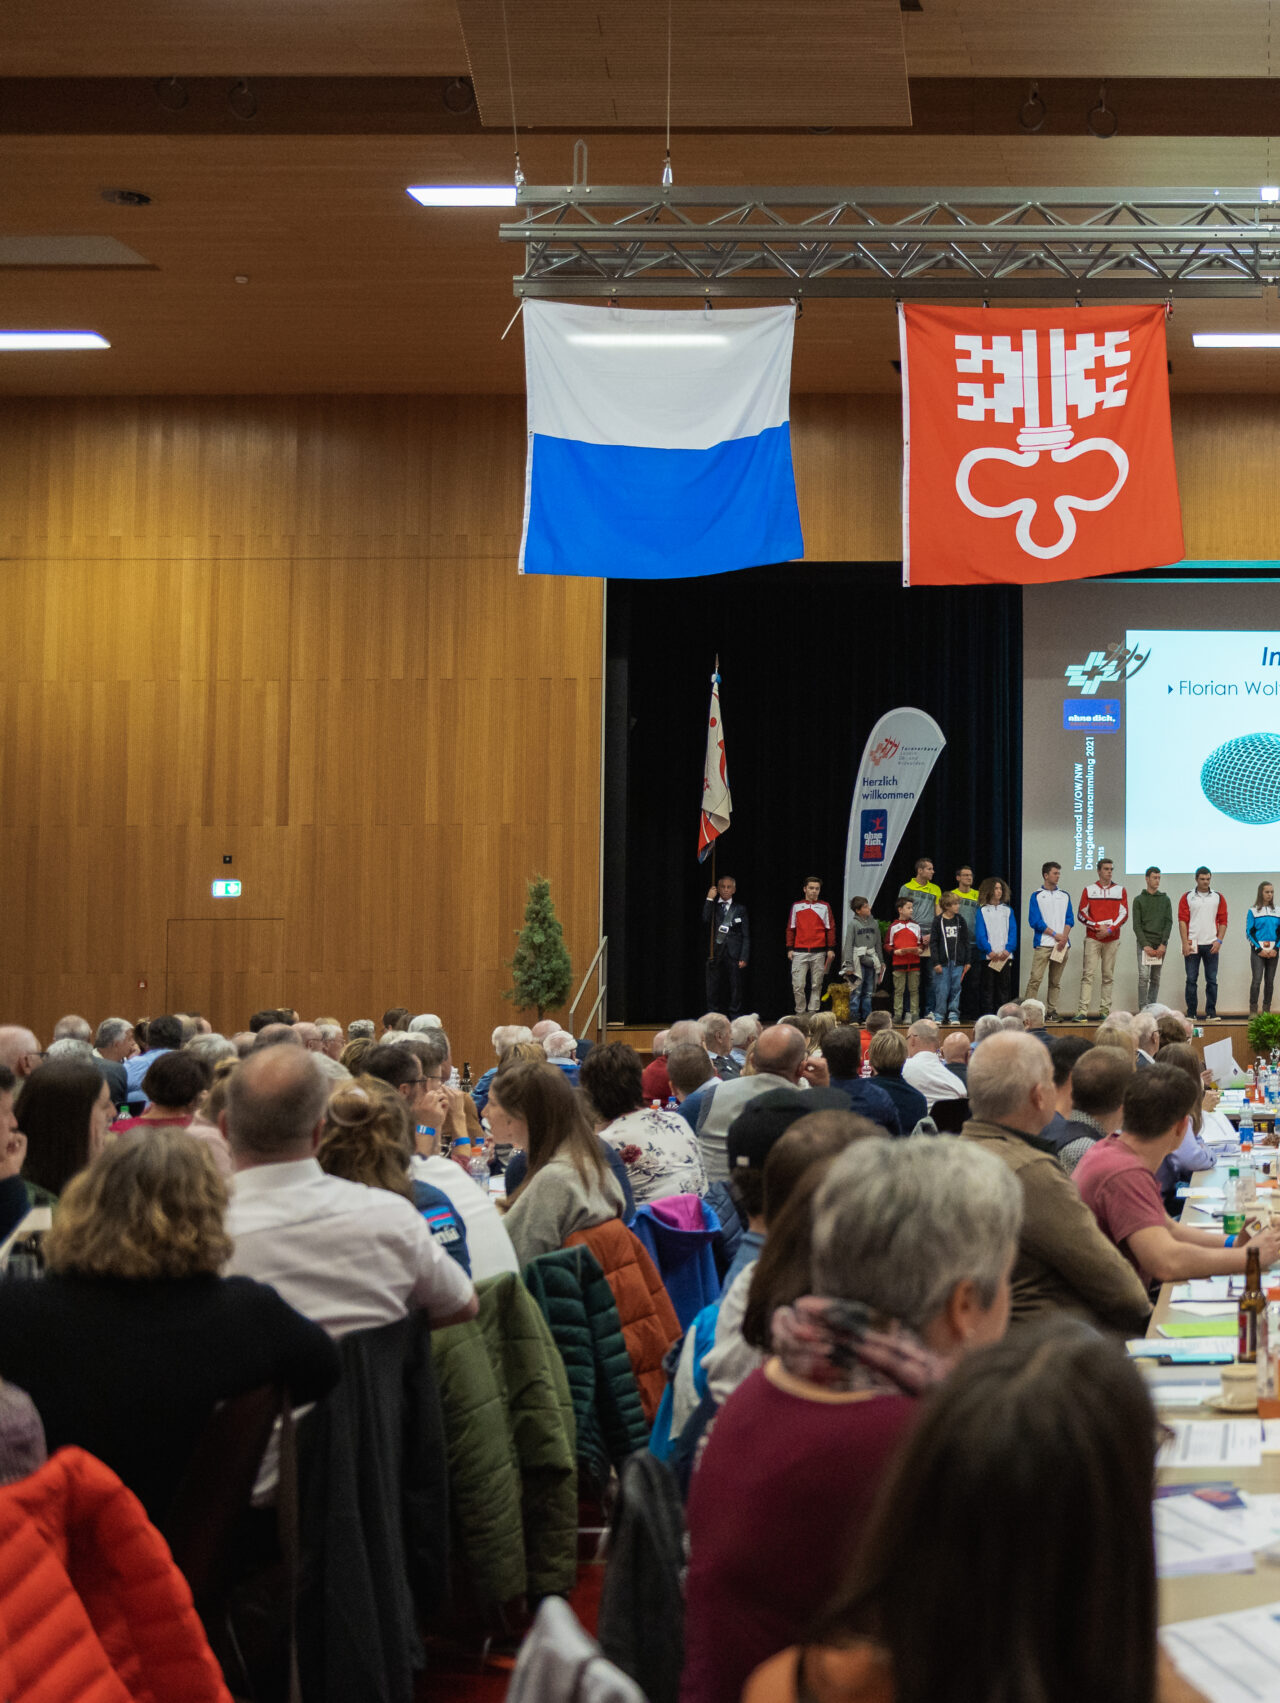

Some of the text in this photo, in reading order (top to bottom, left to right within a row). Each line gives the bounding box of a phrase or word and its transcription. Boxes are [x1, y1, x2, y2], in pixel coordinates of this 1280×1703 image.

[1179, 680, 1238, 696] Florian
[862, 775, 898, 787] Herzlich
[862, 789, 915, 800] willkommen
[1085, 736, 1096, 870] Delegiertenversammlung 2021
[1074, 762, 1084, 871] Turnverband LU/OW/NW
